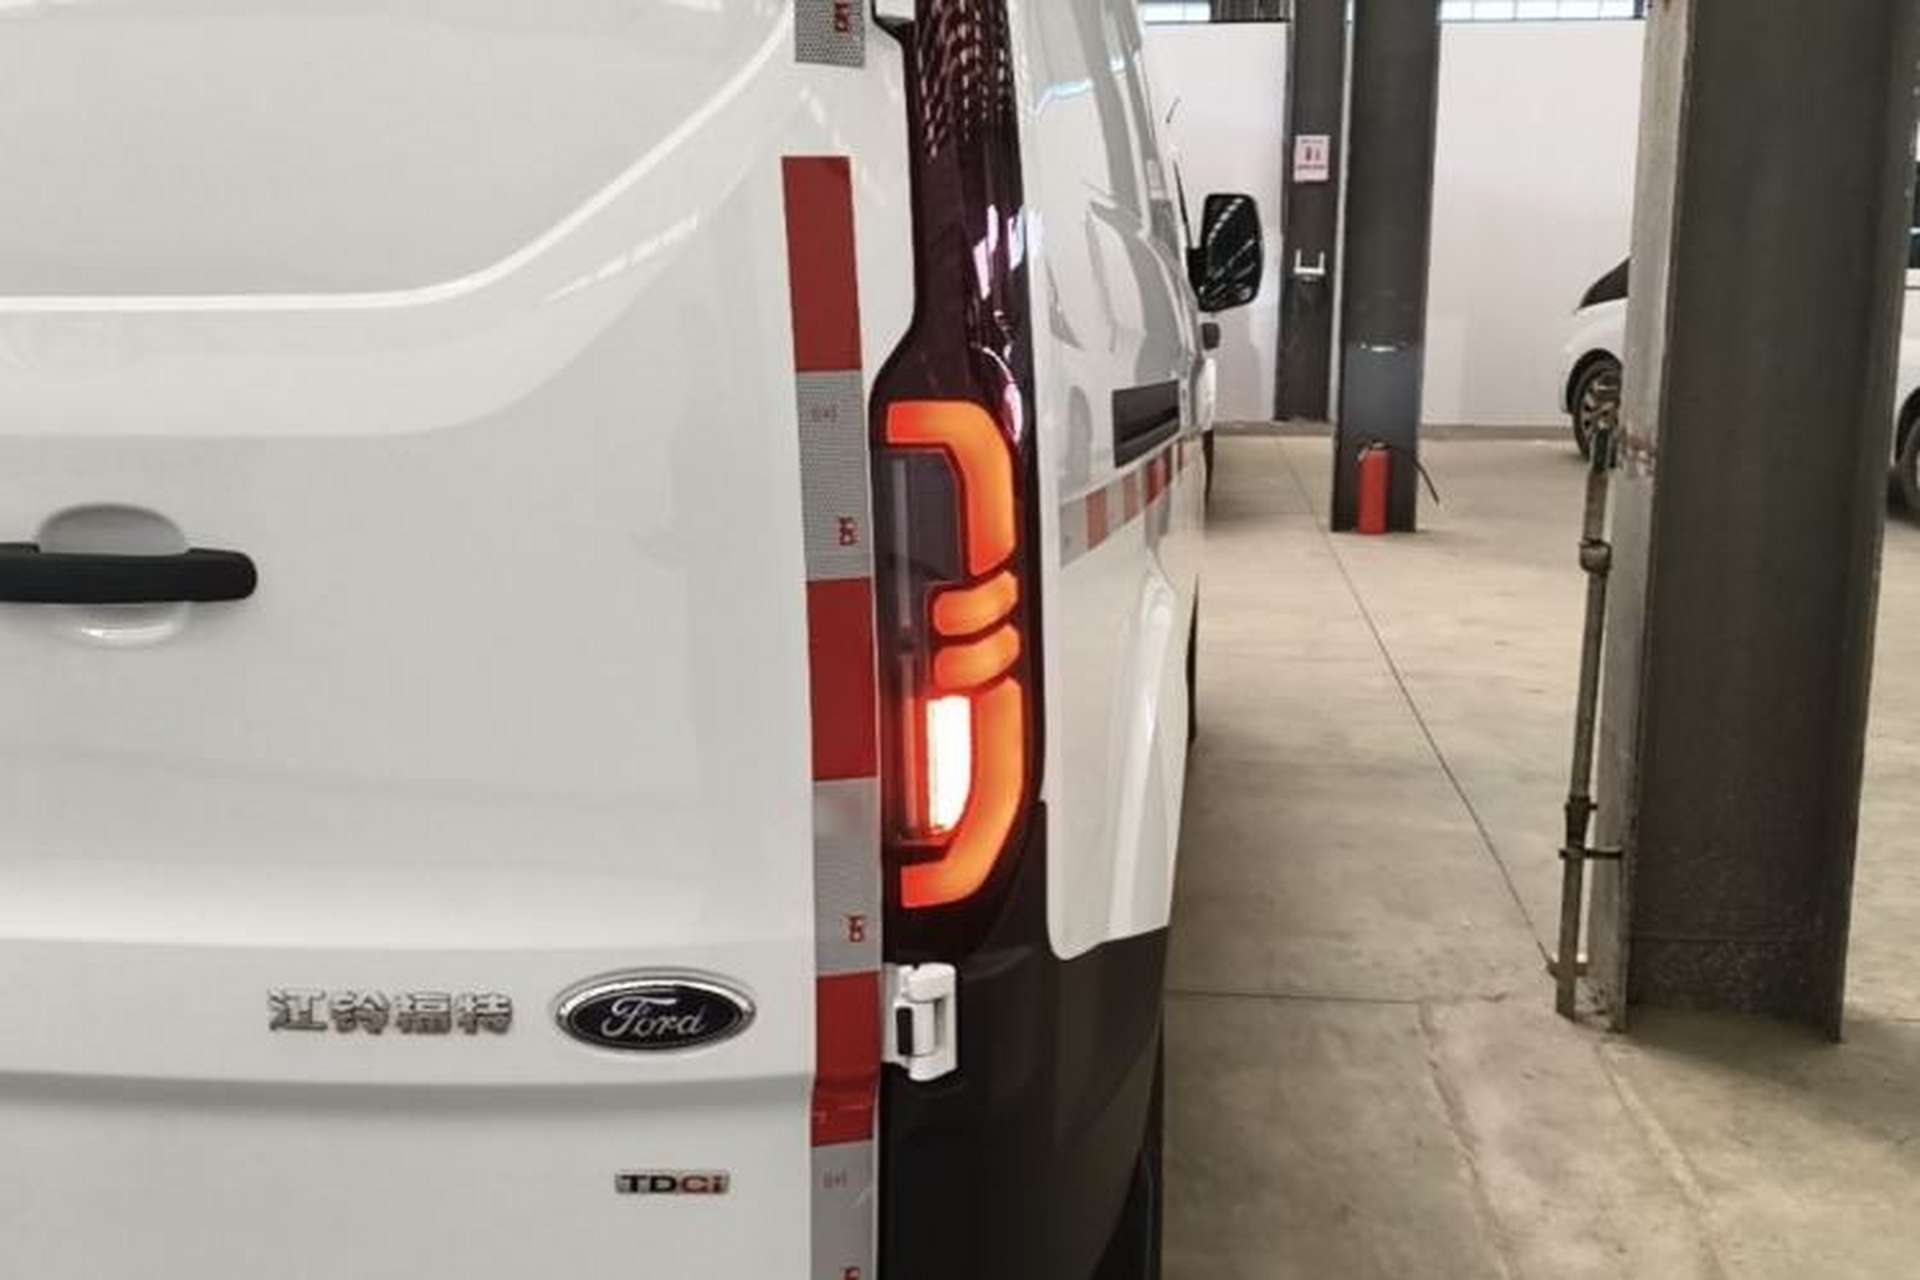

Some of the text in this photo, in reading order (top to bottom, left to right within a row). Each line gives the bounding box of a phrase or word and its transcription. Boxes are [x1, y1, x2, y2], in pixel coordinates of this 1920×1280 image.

[268, 989, 512, 1034] 江铃福特
[601, 996, 705, 1037] Ford
[618, 1172, 725, 1194] TDCi
